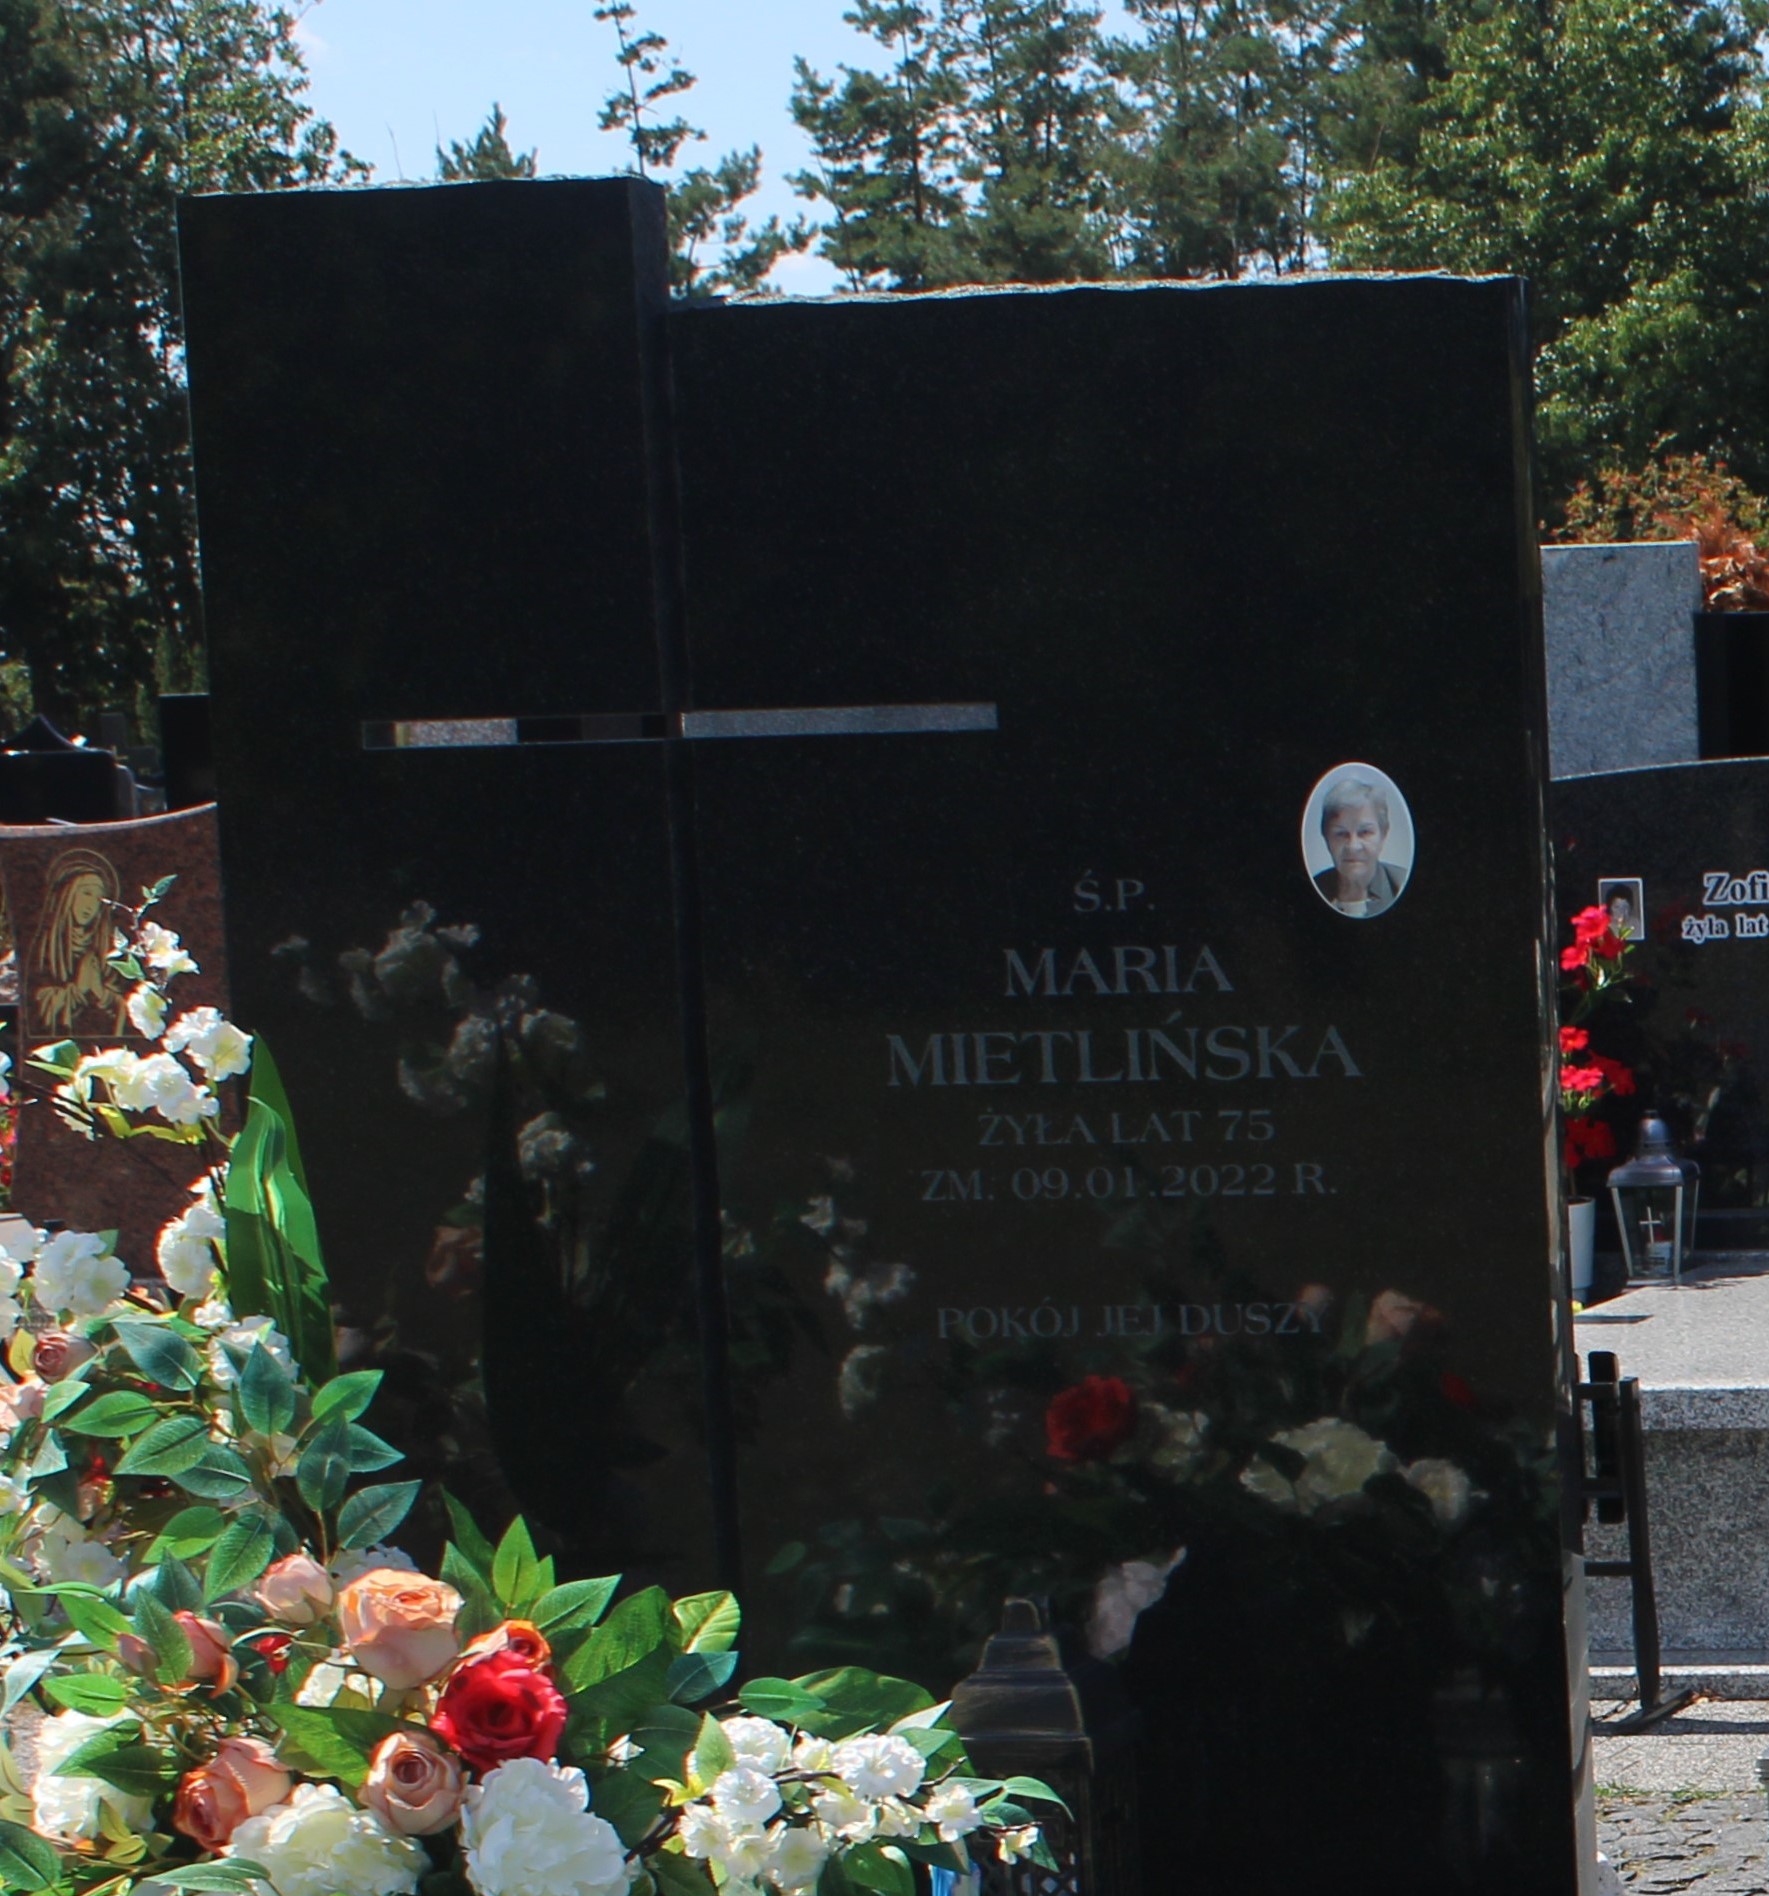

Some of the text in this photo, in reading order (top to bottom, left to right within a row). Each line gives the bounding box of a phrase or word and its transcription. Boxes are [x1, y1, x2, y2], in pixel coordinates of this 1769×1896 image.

[1073, 869, 1156, 913] Ś.P.
[1735, 914, 1769, 936] lat
[1003, 945, 1235, 997] MARIA
[885, 1009, 1365, 1088] MIETLIŃSKA
[978, 1107, 1276, 1147] ŻYŁA LAT 75
[921, 1163, 1338, 1201] ZM. 09.01.2022 R.
[937, 1297, 1328, 1340] POKÓJ JEJ DUSZY
